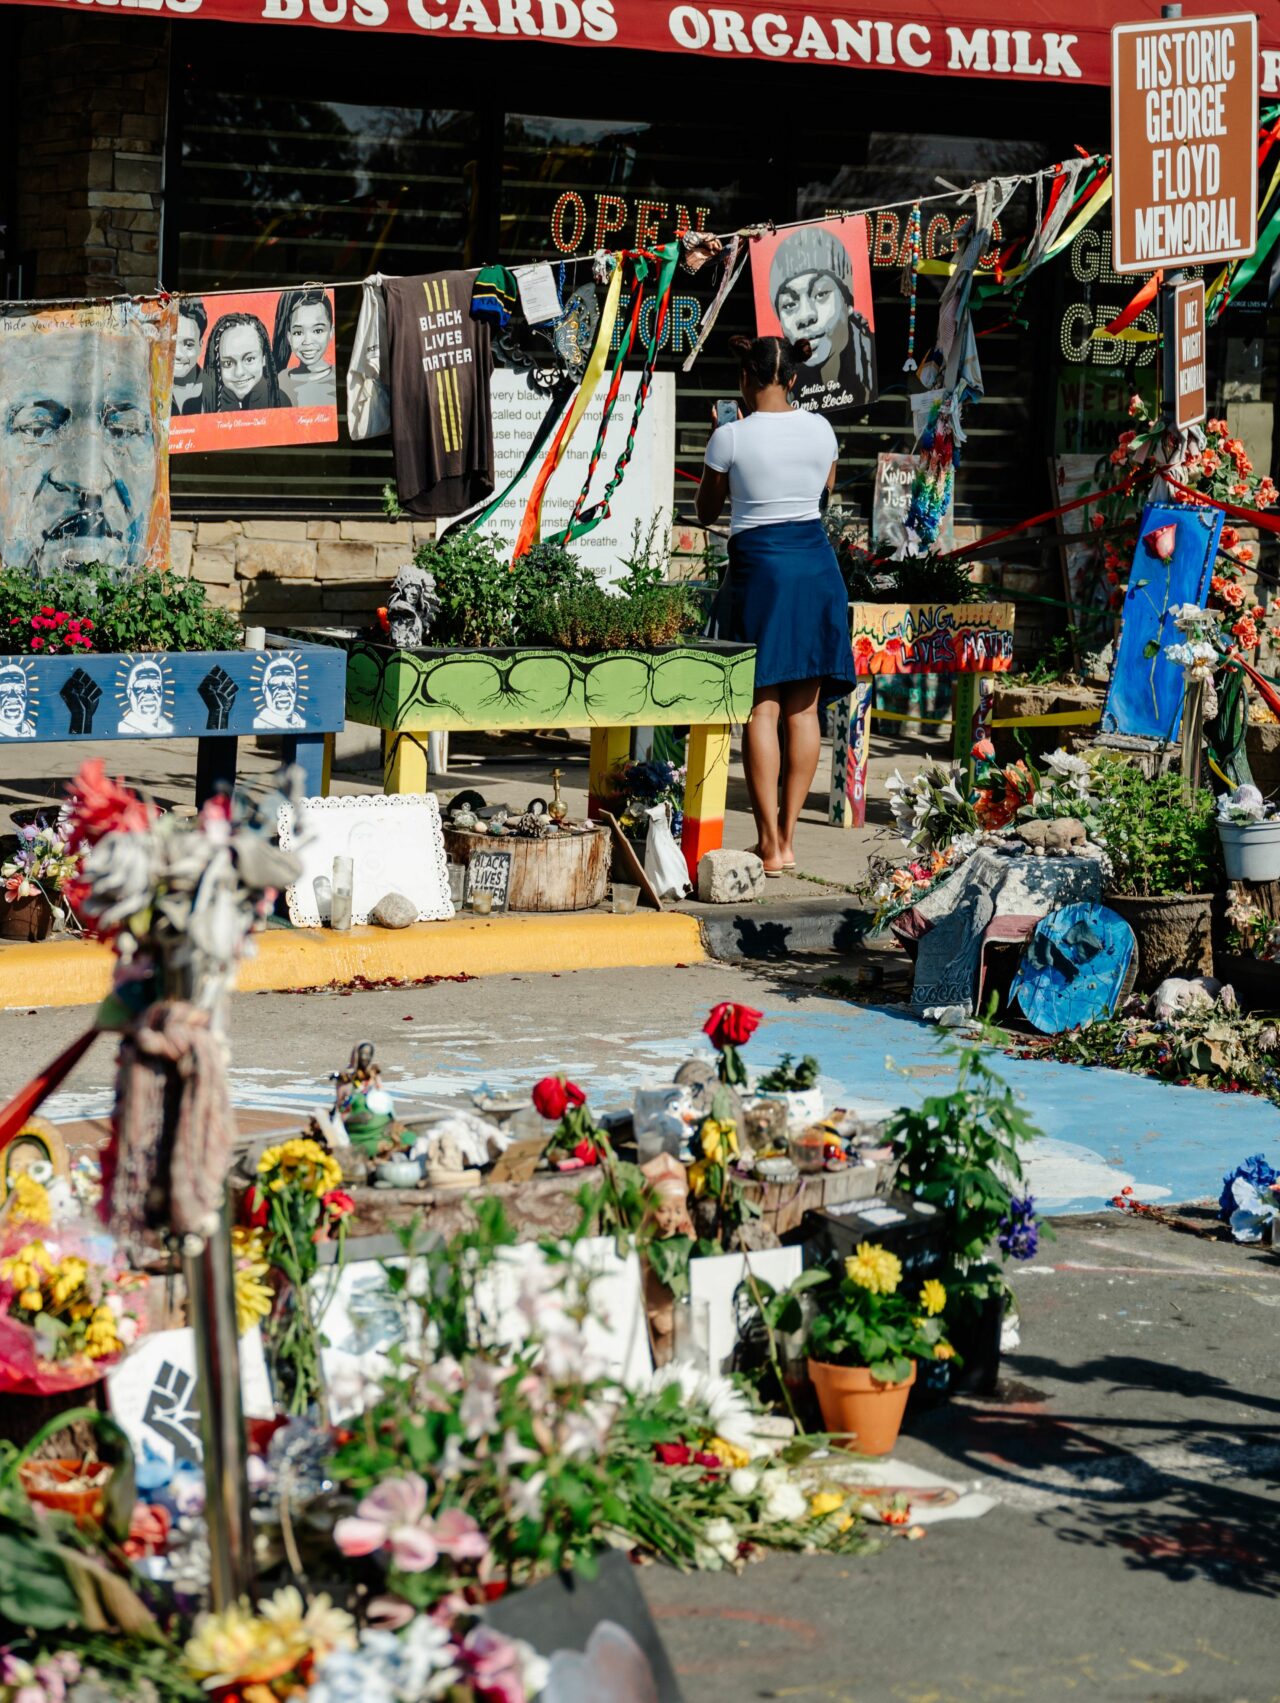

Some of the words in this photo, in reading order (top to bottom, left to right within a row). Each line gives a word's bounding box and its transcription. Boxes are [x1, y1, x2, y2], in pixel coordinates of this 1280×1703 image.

[409, 0, 618, 42] CARDS
[668, 5, 932, 67] ORGANIC
[945, 27, 1083, 78] MILK
[1135, 28, 1236, 90] HISTORIC
[1146, 84, 1228, 143] GEORGE
[1152, 144, 1220, 202] FLOYD
[551, 191, 710, 256] OPEN
[1135, 197, 1242, 260] MEMORIAL
[419, 309, 463, 331] BLACK
[1184, 300, 1198, 329] INEZ
[424, 330, 463, 351] LIVES
[422, 348, 472, 372] MATTER
[800, 381, 825, 398] Justice
[826, 379, 841, 391] For
[1179, 364, 1205, 396] MEMORIAL
[490, 391, 514, 403] very
[821, 390, 854, 409] Locke
[492, 409, 522, 420] called
[525, 410, 542, 421] out
[567, 449, 589, 459] than
[500, 519, 516, 531] my
[580, 535, 618, 547] breathe
[882, 605, 955, 640] GANG
[901, 632, 956, 666] LIVES
[964, 630, 1014, 665] MATTER
[474, 854, 508, 870] BLACK
[475, 869, 501, 886] LIVES
